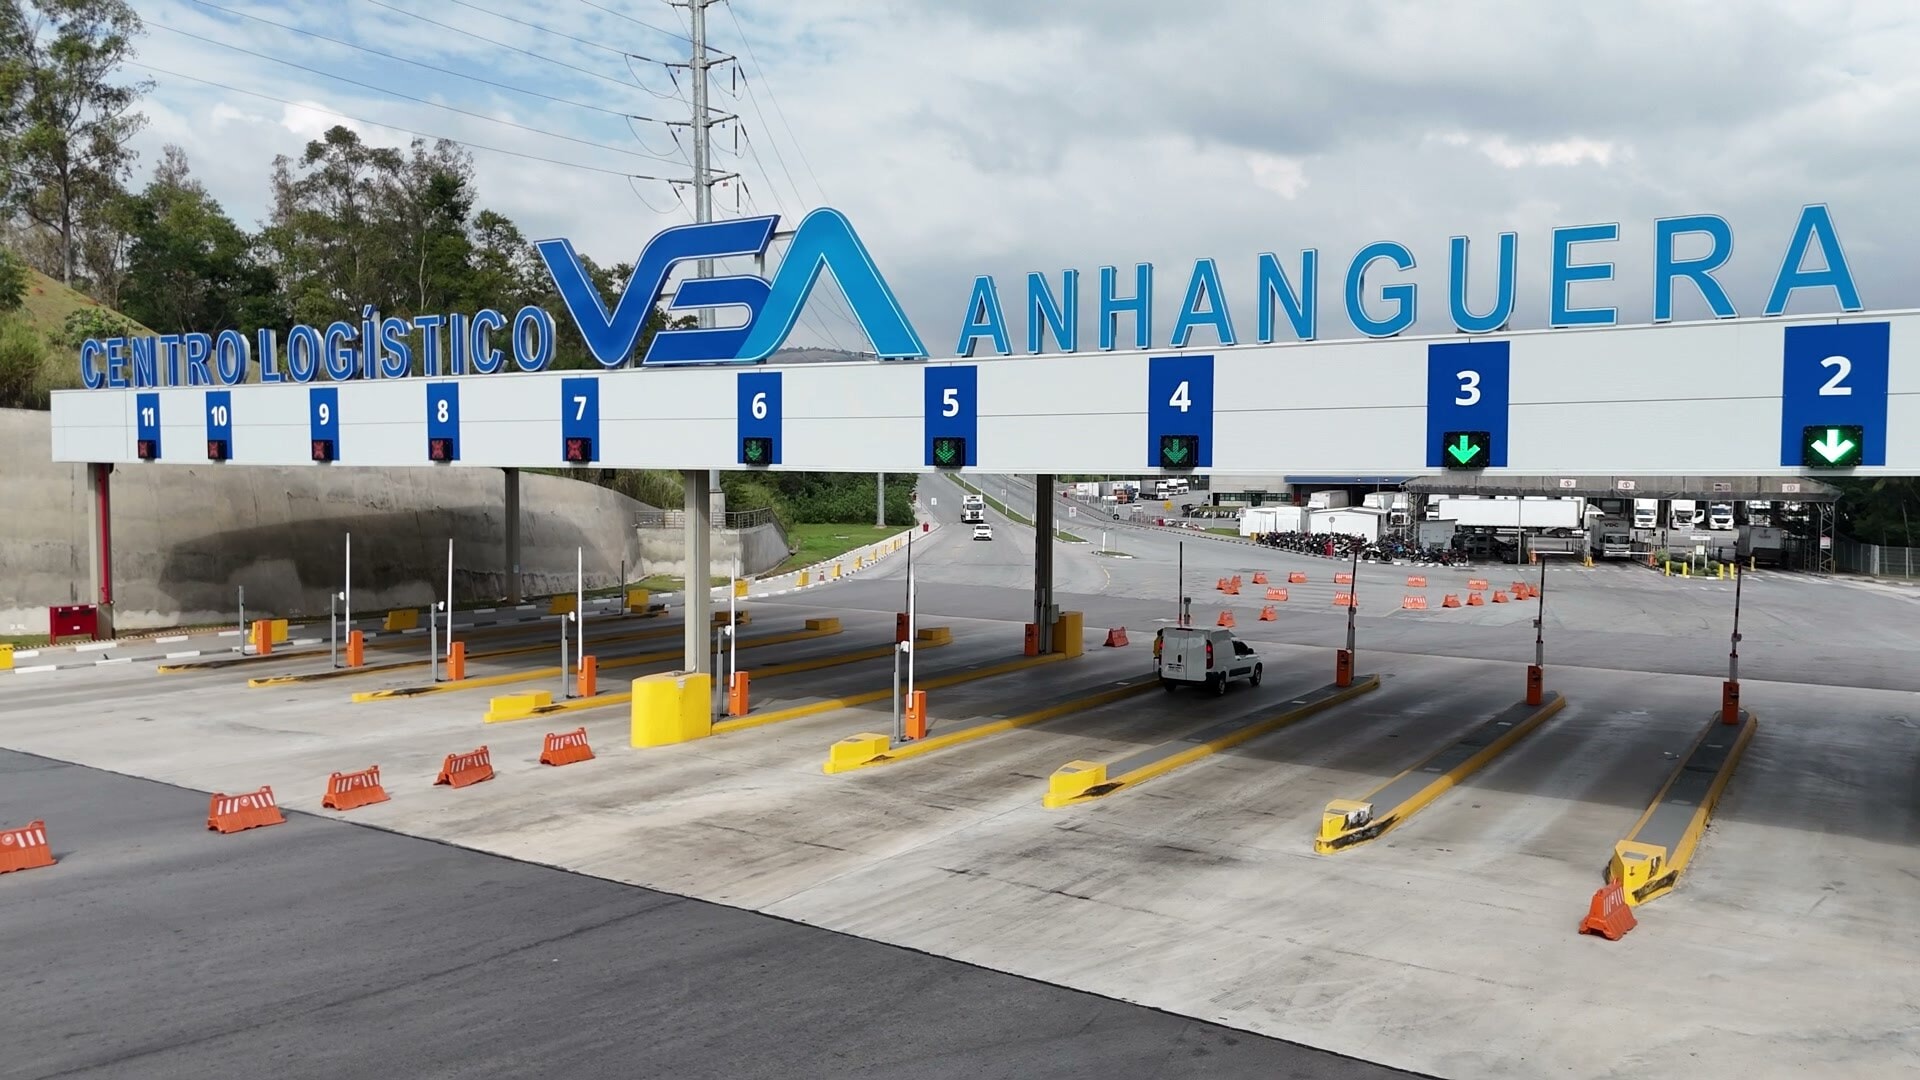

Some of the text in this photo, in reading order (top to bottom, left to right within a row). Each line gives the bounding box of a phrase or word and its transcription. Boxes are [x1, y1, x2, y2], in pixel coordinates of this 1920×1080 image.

[80, 329, 250, 390] CENTRO
[258, 303, 557, 384] LOGÍSTICO
[956, 202, 1866, 358] ANHANGUERA
[1455, 370, 1481, 406] 3
[1818, 355, 1852, 396] 2
[437, 399, 449, 423] 8
[573, 396, 587, 421] 7
[751, 392, 767, 420] 6
[942, 388, 959, 418] 5
[1169, 381, 1192, 413] 4
[141, 407, 155, 427] 11
[210, 405, 228, 427] 10
[318, 403, 330, 426] 9
